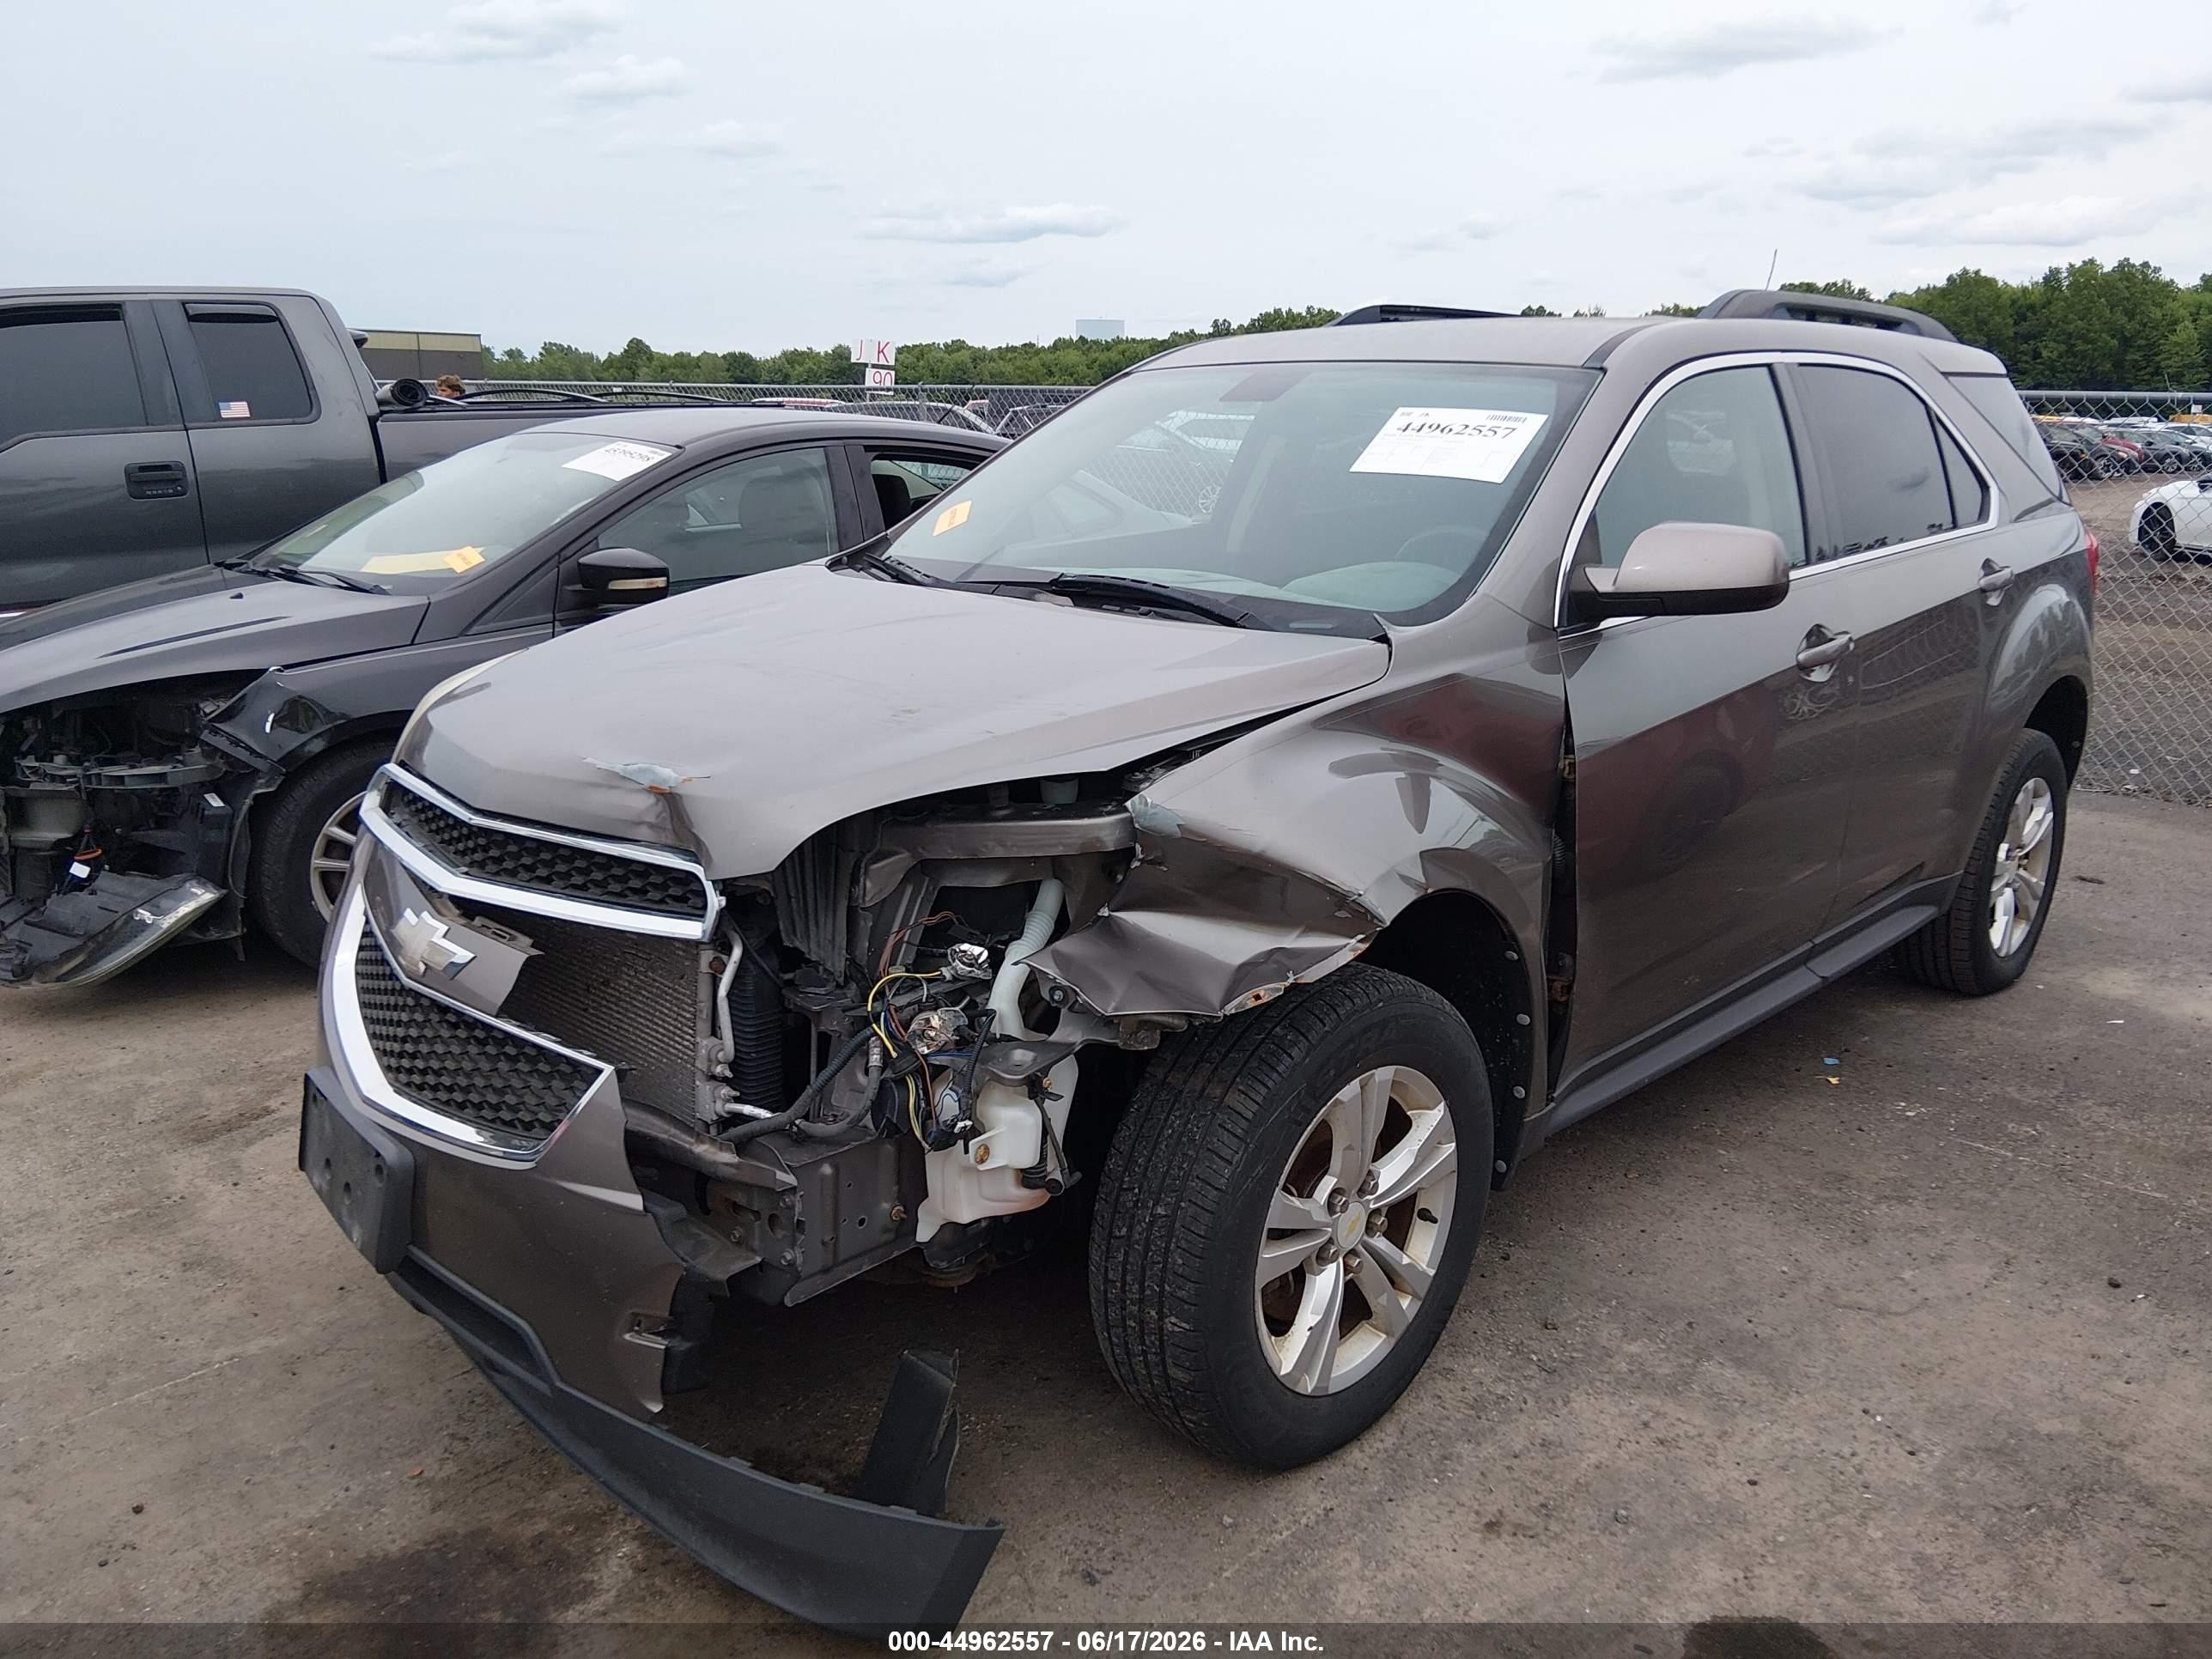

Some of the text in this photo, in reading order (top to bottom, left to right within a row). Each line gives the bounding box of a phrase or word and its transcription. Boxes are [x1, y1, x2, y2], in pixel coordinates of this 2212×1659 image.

[856, 339, 890, 363] J K
[1398, 422, 1517, 439] 44962557
